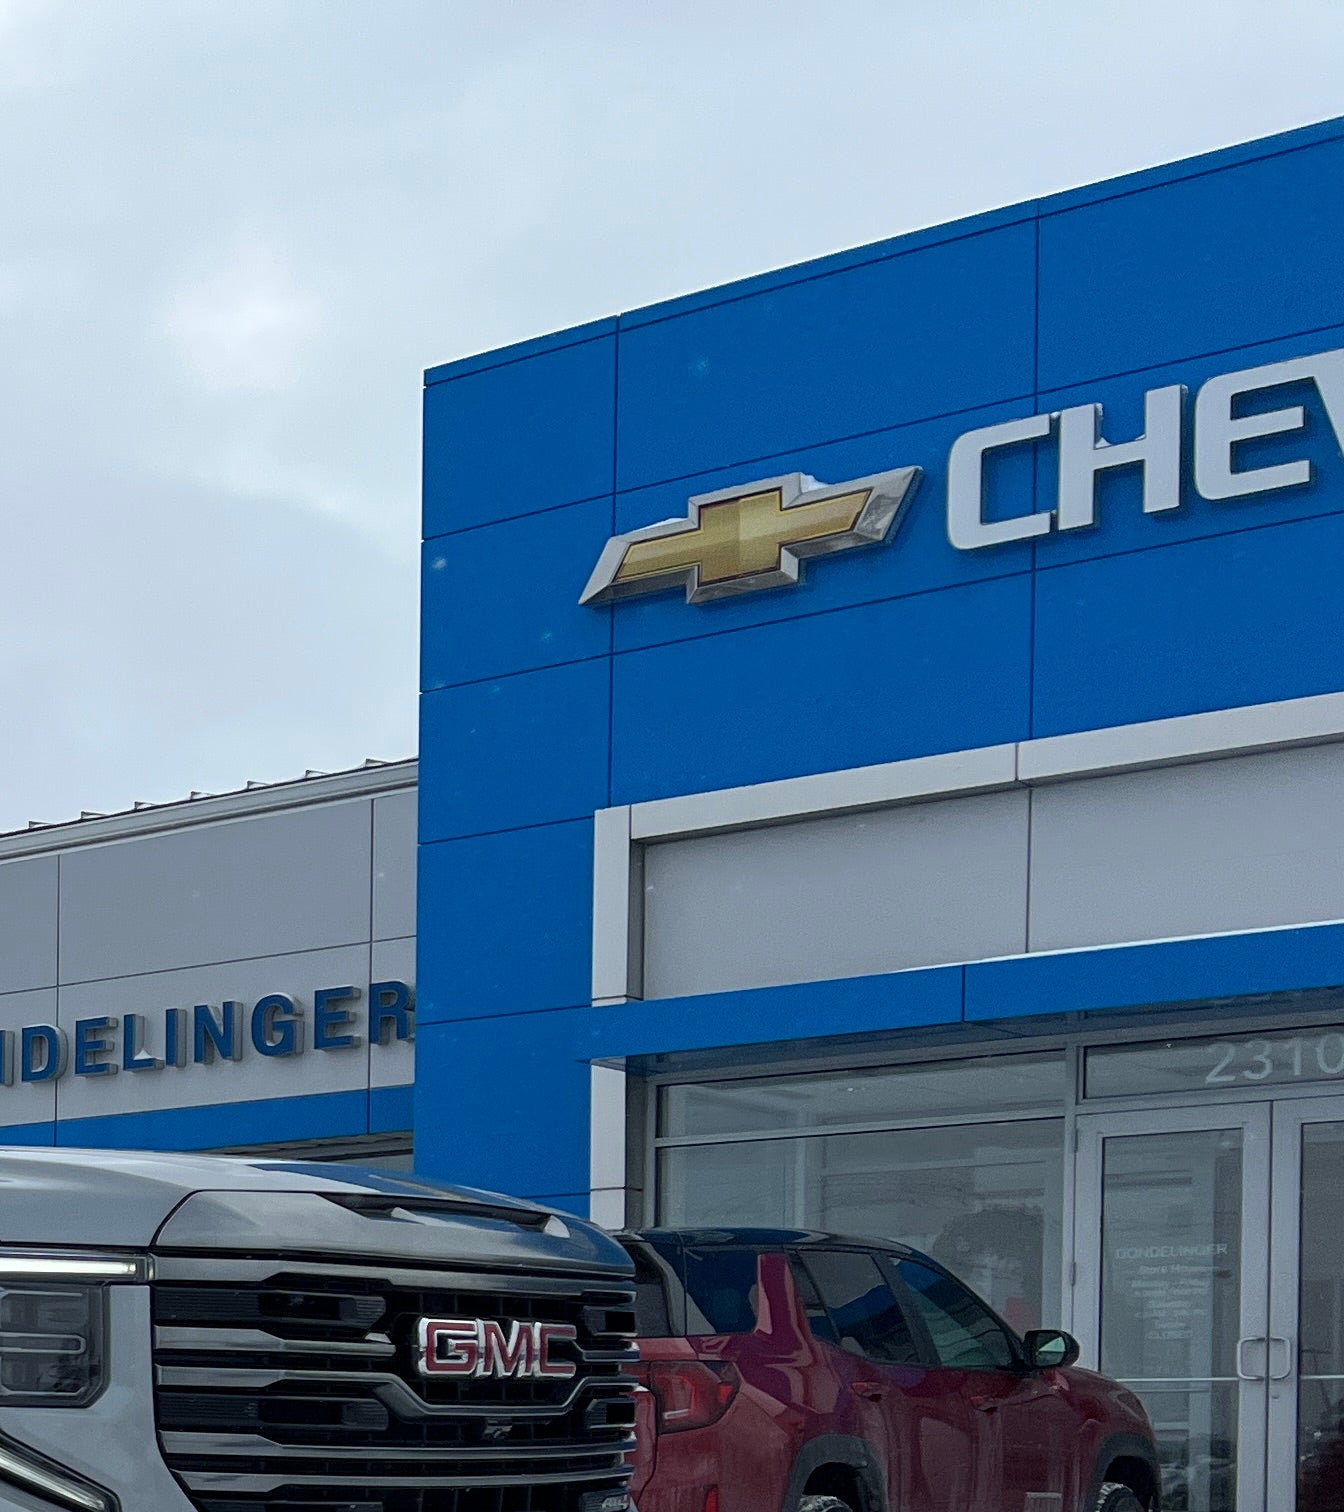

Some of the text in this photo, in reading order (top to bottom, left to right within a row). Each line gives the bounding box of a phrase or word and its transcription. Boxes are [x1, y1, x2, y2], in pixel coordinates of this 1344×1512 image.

[947, 347, 1344, 550] CHE
[1205, 1033, 1344, 1083] 2310
[418, 1318, 576, 1378] GMC
